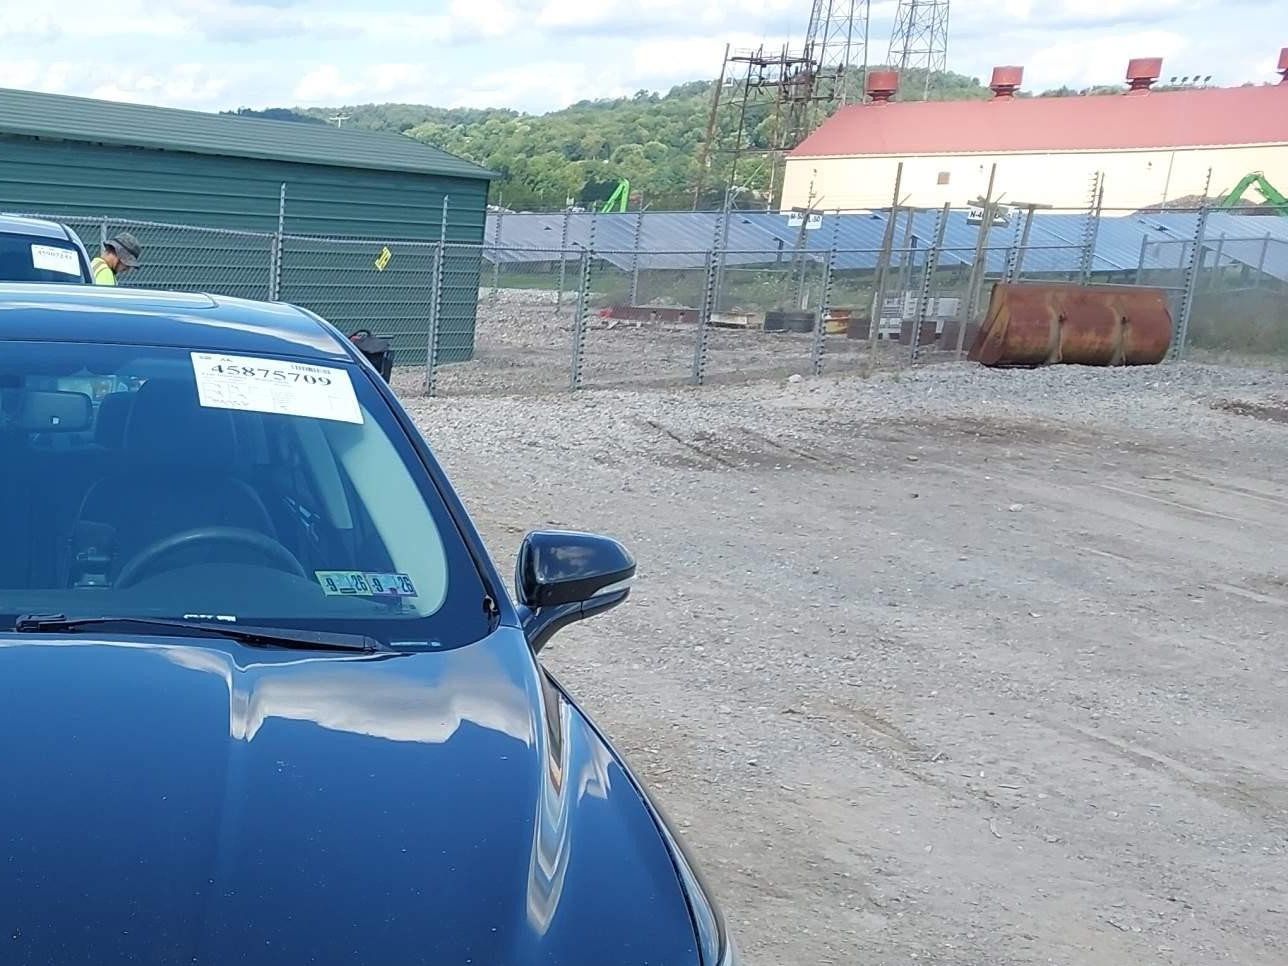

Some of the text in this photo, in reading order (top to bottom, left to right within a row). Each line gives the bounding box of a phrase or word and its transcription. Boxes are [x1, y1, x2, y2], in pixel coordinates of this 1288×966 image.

[211, 364, 332, 386] 45875709
[350, 574, 368, 591] 26
[396, 576, 414, 593] 26
